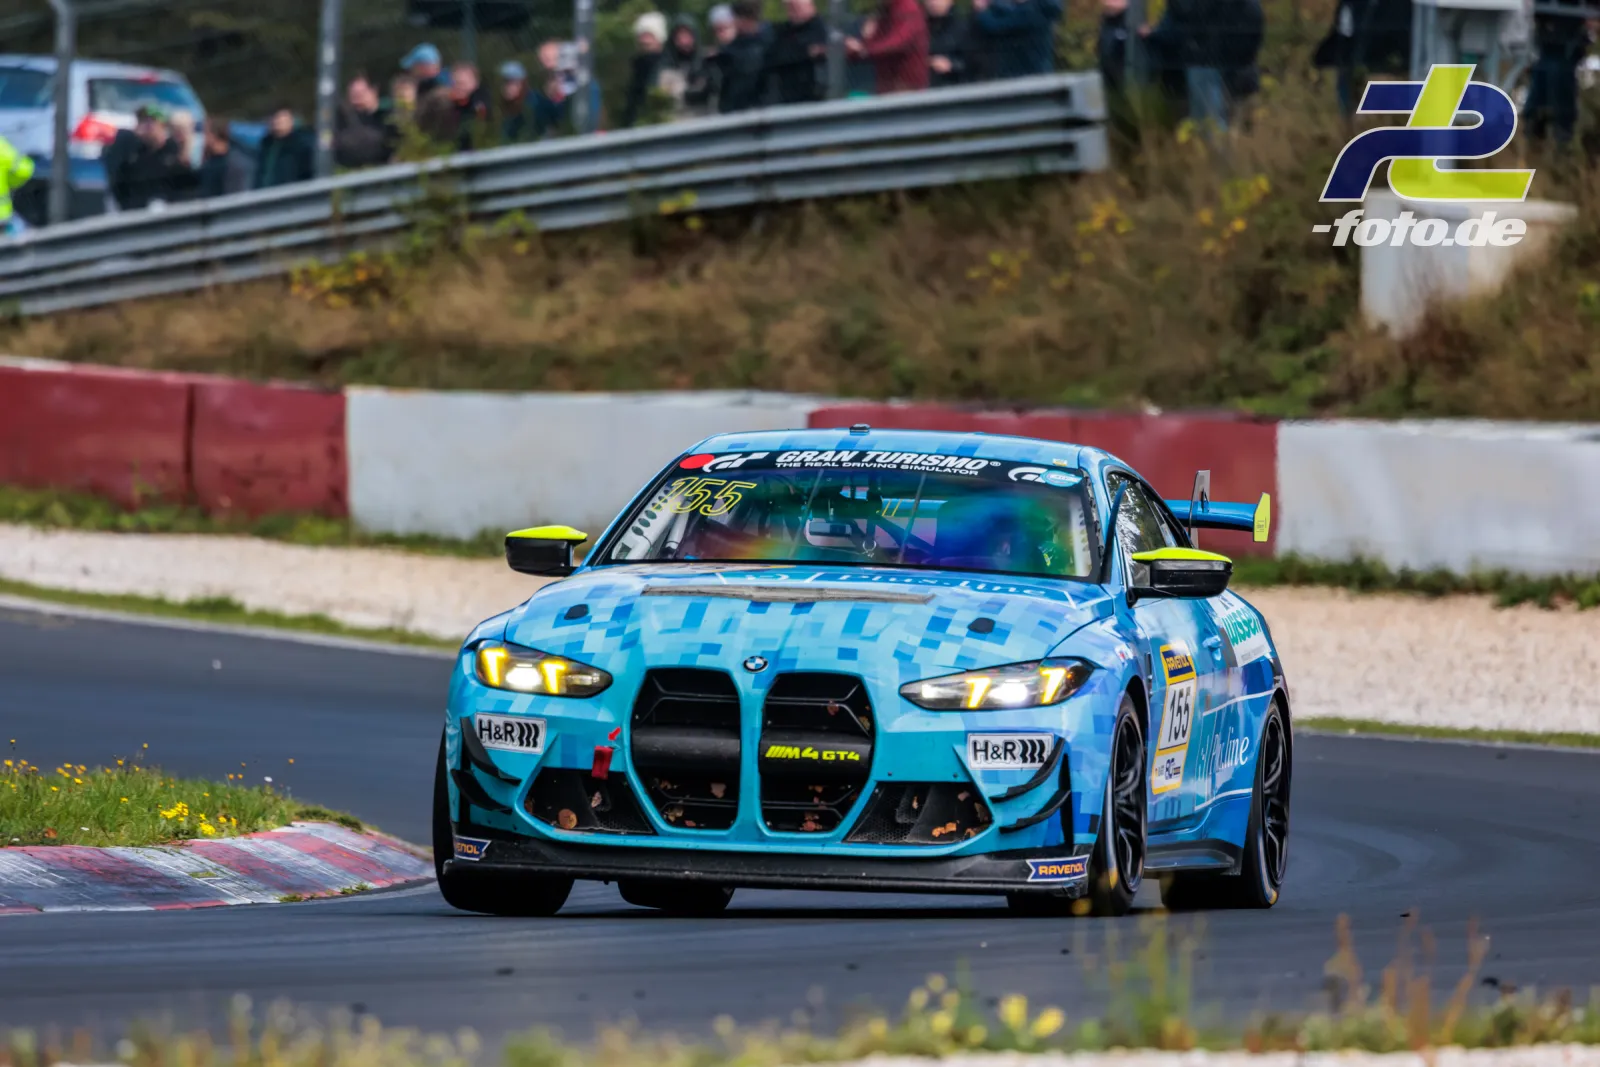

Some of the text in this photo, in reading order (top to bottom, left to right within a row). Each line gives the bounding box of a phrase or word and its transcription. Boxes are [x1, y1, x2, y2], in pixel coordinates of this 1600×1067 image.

[775, 451, 861, 464] GRAN
[842, 462, 897, 470] DRIVING
[900, 464, 979, 476] SIMULATOR
[651, 476, 757, 516] 155
[1168, 686, 1191, 743] 155
[478, 718, 515, 743] H&R
[822, 750, 860, 761] GT4
[972, 739, 1017, 762] H&R
[1038, 862, 1085, 876] RAVENOL
